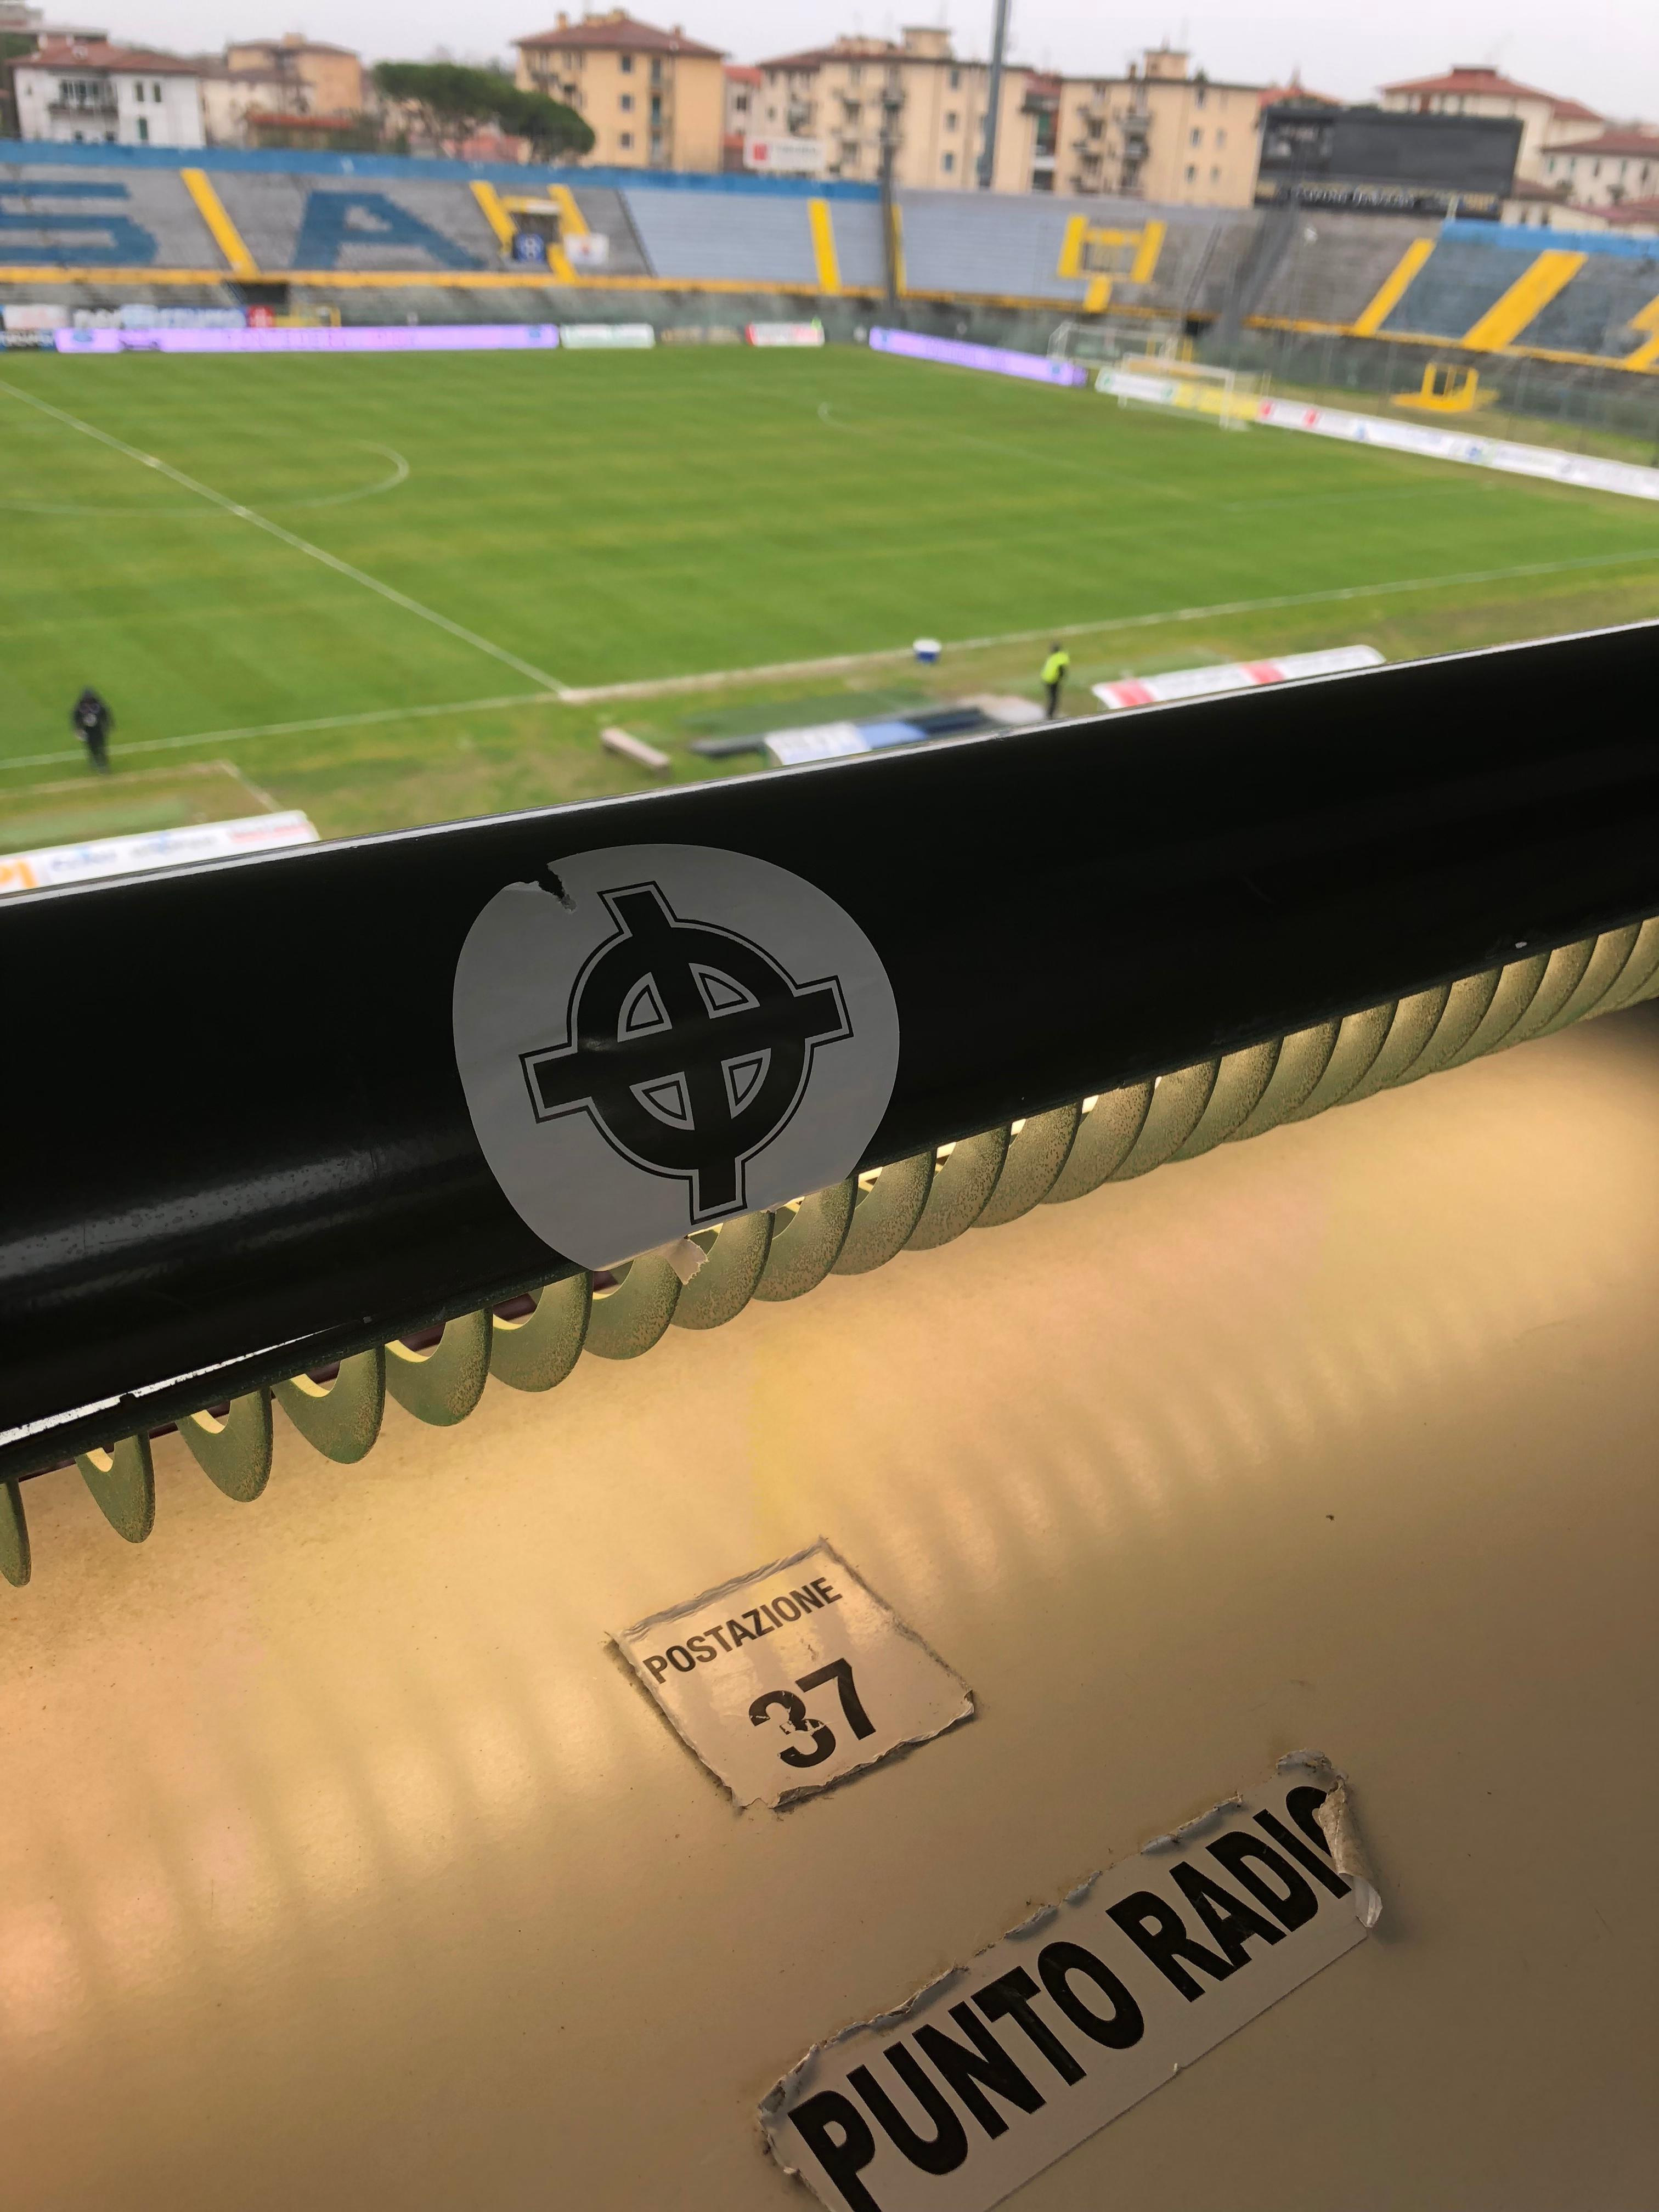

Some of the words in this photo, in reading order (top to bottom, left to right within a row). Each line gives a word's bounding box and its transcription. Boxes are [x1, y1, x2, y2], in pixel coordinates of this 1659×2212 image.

[642, 1577, 843, 1684] POSTAZIONE
[748, 1657, 876, 1768] 37
[787, 1942, 1144, 2212] PUNTO
